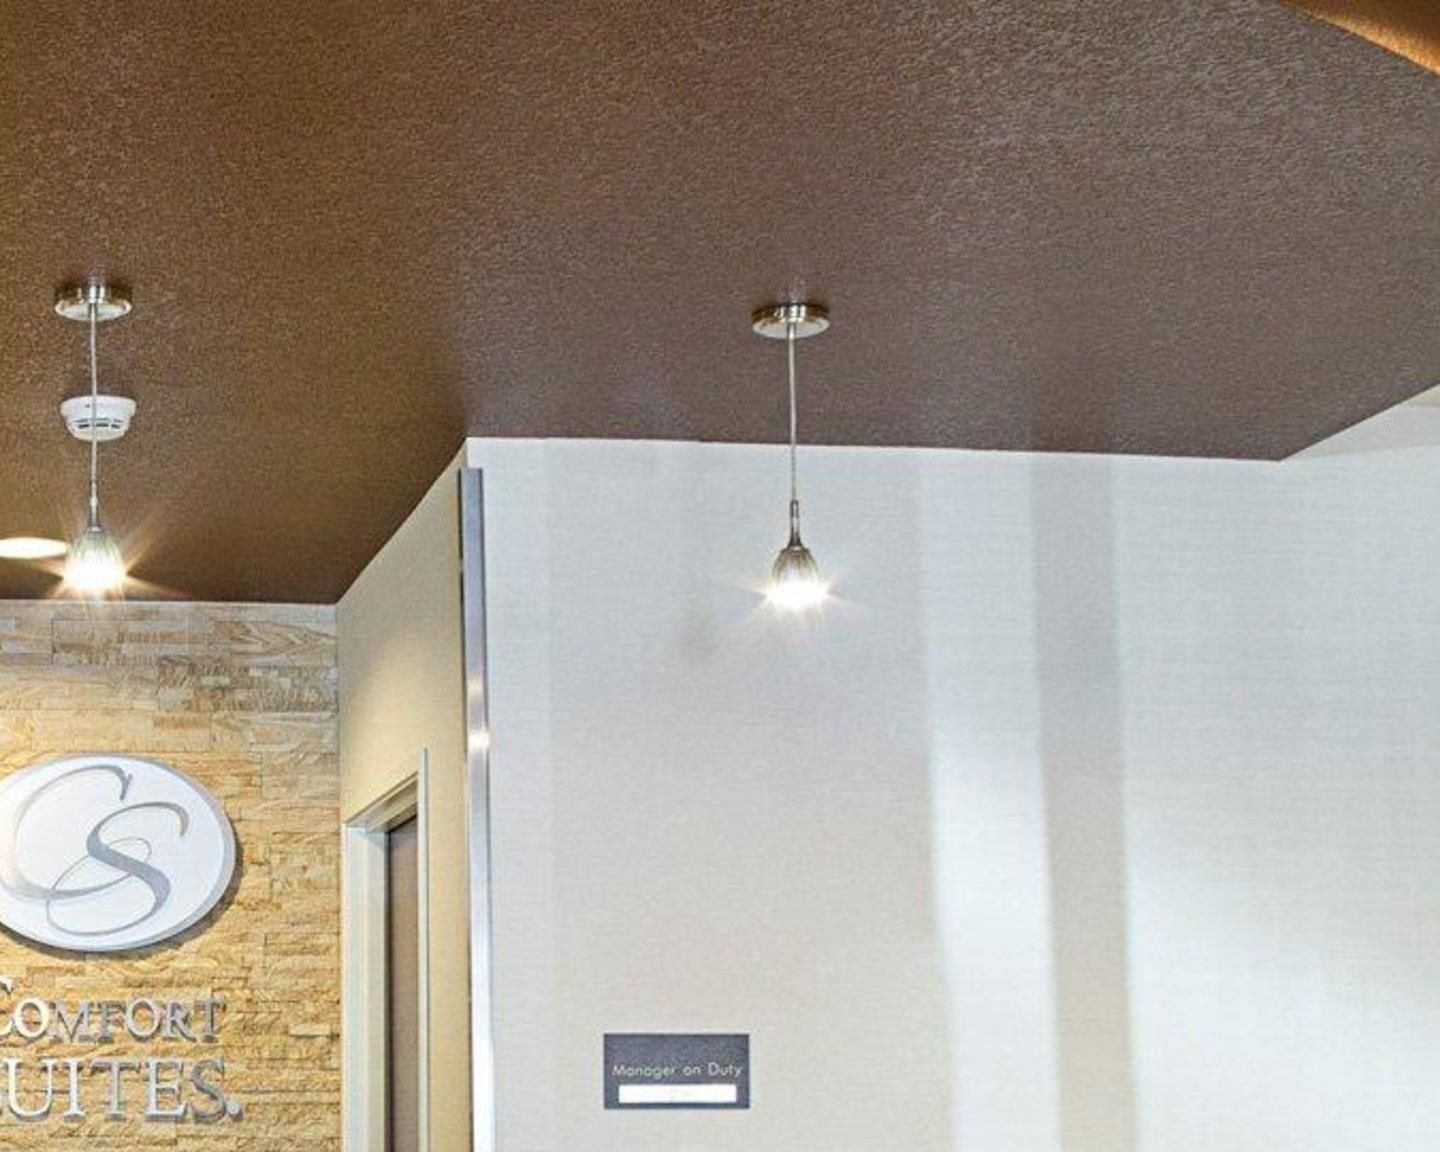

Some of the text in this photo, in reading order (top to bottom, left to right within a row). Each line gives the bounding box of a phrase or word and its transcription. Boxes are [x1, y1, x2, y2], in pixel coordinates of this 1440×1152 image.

[612, 1062, 742, 1080] Manager on Duty
